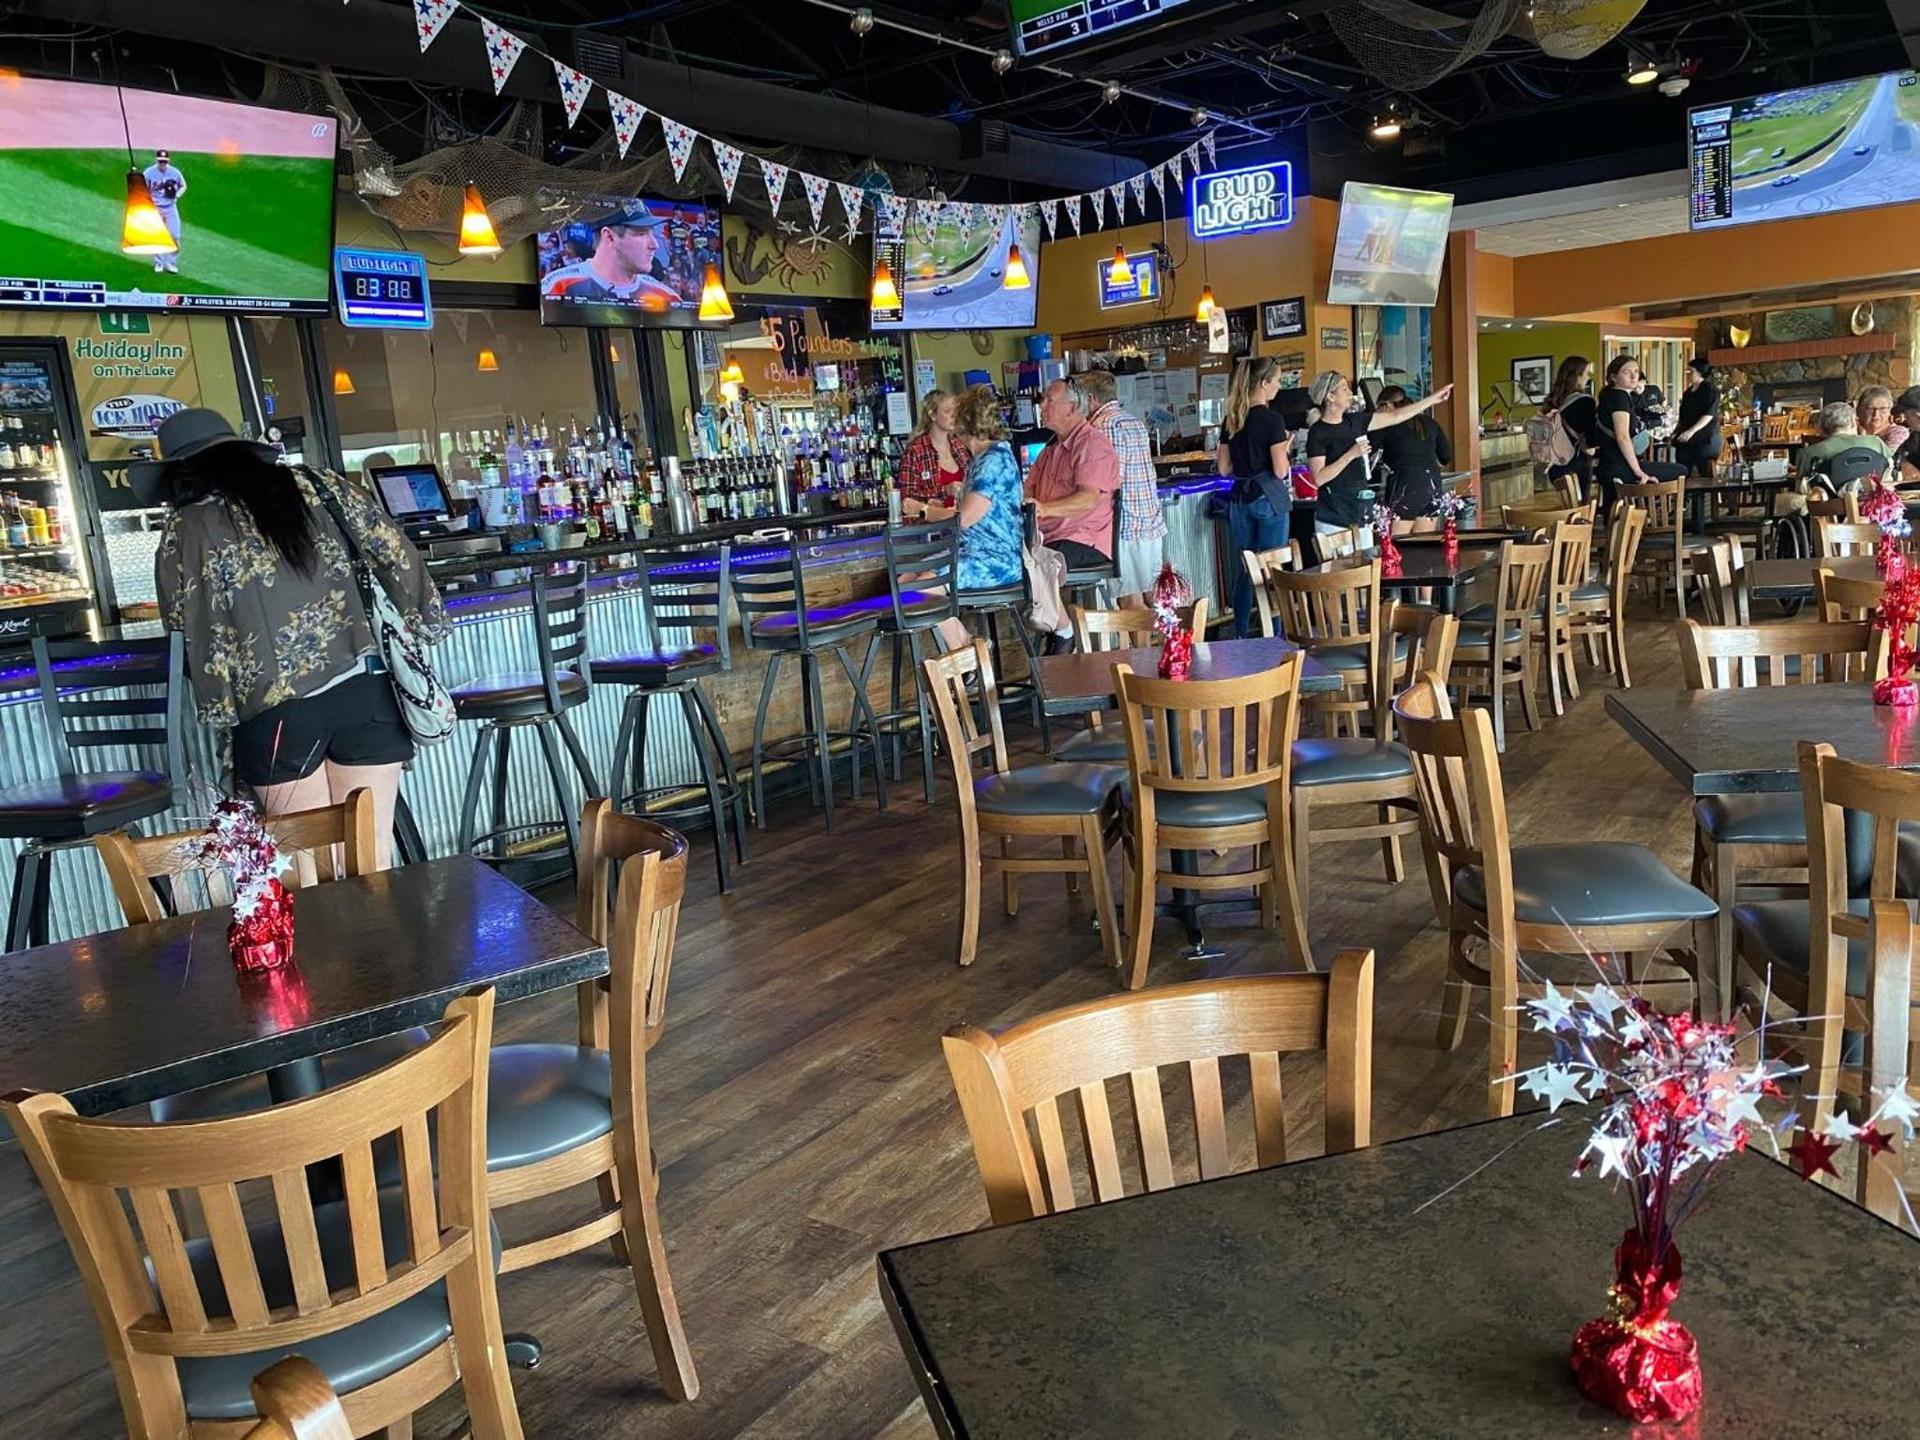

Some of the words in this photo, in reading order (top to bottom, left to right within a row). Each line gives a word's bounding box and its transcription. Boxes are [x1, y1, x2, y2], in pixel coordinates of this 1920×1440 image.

[1071, 22, 1080, 35] 3
[1210, 170, 1275, 204] BUD
[1198, 193, 1287, 230] LIGHT
[347, 255, 375, 269] BUD
[375, 259, 410, 272] LIGHT
[23, 291, 32, 301] 3
[90, 293, 97, 303] 1
[760, 315, 785, 352] $5
[789, 320, 852, 355] Pounders
[76, 339, 151, 362] Holiday
[155, 340, 183, 359] Inn
[94, 365, 113, 377] On
[117, 365, 142, 376] The
[145, 365, 176, 377] Lake
[106, 399, 132, 408] THE
[96, 411, 128, 425] ICE
